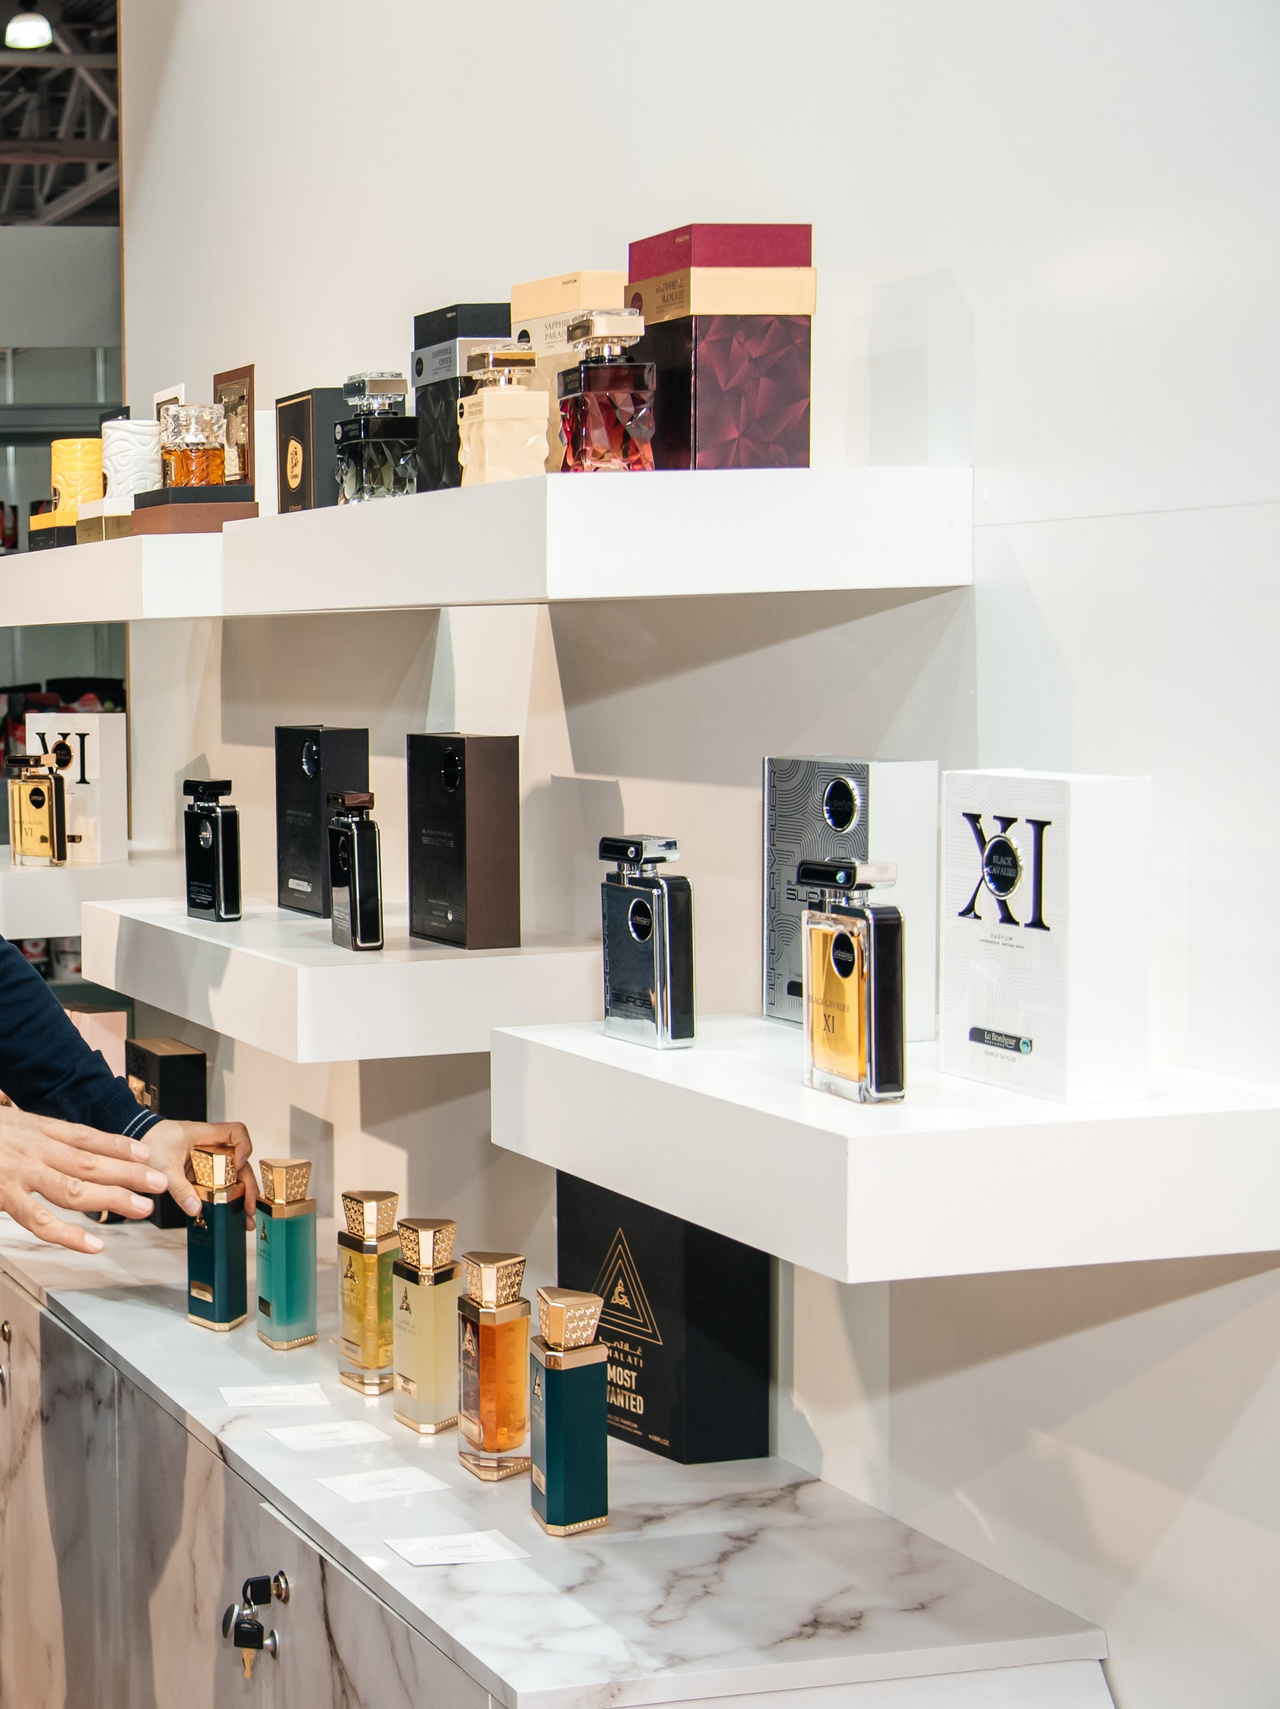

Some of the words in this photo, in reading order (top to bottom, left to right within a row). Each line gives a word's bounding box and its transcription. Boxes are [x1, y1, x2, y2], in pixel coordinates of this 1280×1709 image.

[662, 290, 685, 304] ROUGE
[544, 318, 571, 331] SAPPHIR
[544, 330, 567, 341] PARAD
[23, 826, 34, 837] VI
[992, 855, 1013, 867] BLACK
[958, 811, 1052, 932] XI
[987, 864, 1017, 878] CAVALIER
[990, 932, 1013, 942] PARFUM
[612, 991, 653, 1010] SURGE
[823, 1013, 836, 1034] XI
[984, 1030, 992, 1041] Le
[991, 1032, 1016, 1049] Bonheur
[606, 1363, 638, 1391] MOST
